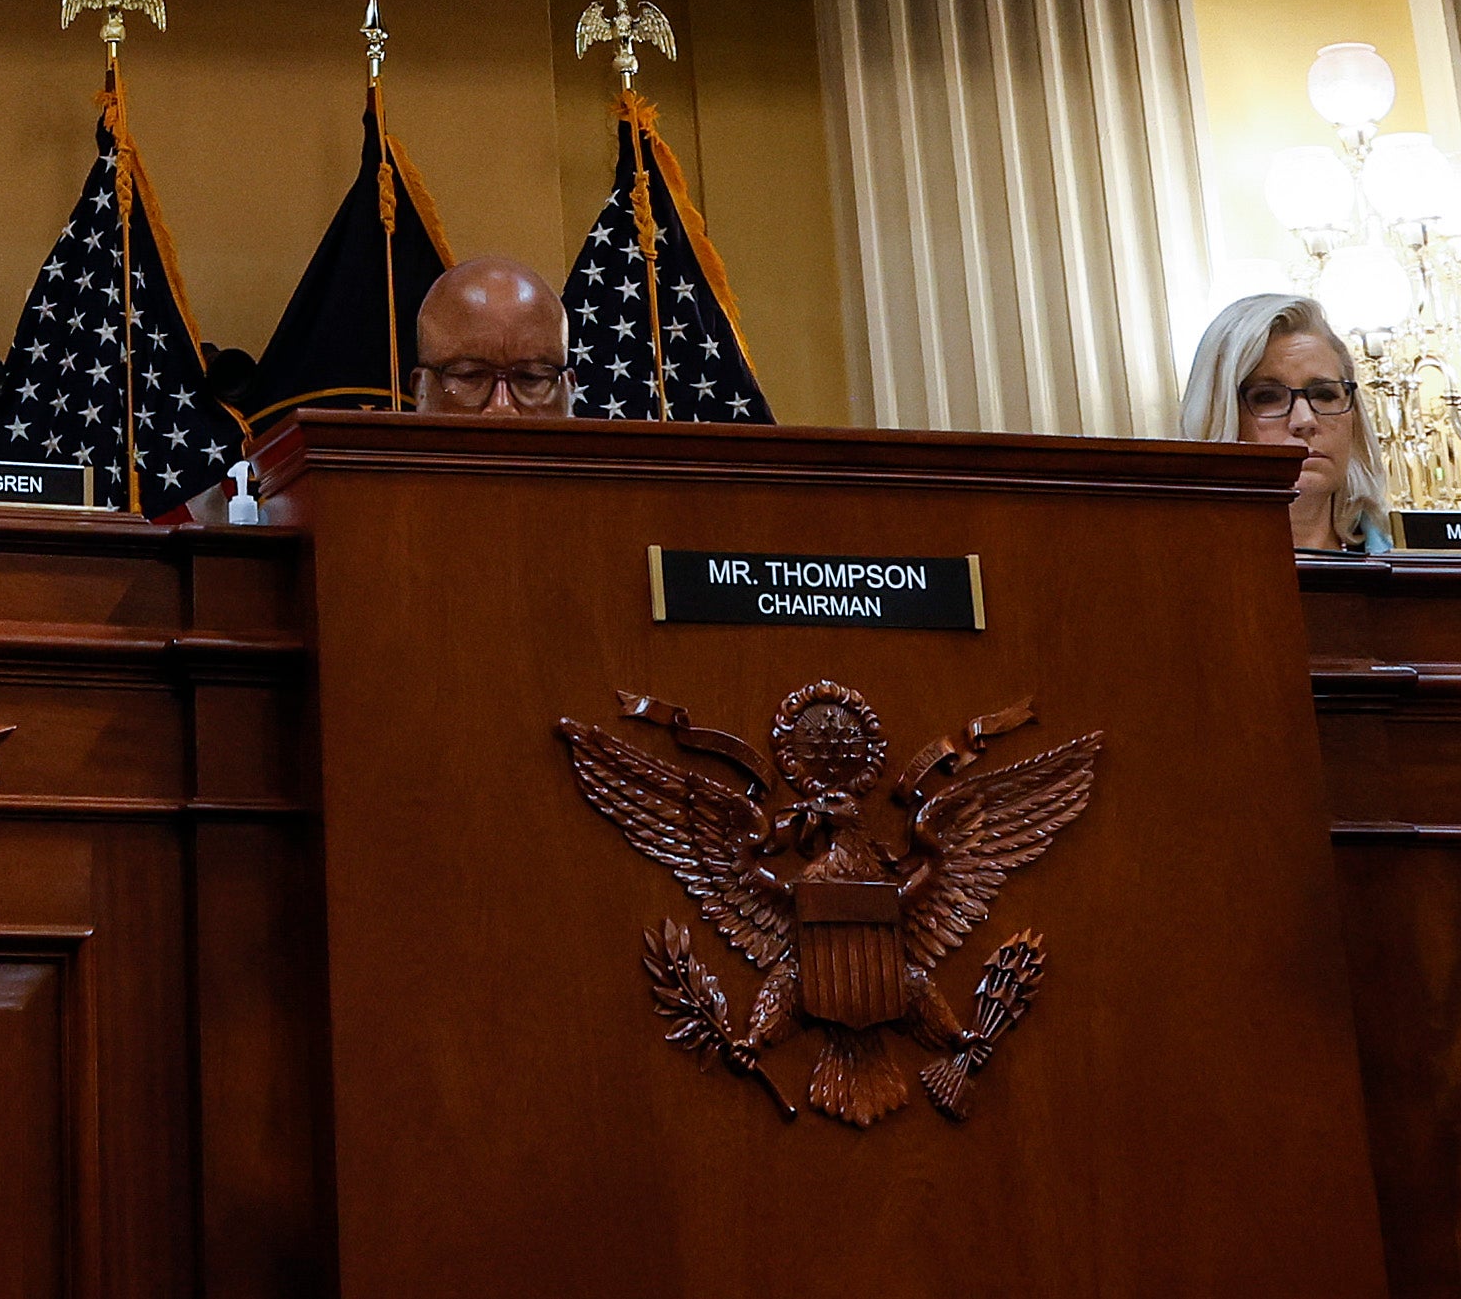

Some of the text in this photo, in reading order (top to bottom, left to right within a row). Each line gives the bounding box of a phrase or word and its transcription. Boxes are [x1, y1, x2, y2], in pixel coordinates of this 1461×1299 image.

[708, 559, 927, 590] MR. THOMPSON
[757, 593, 882, 617] CHAIRMAN
